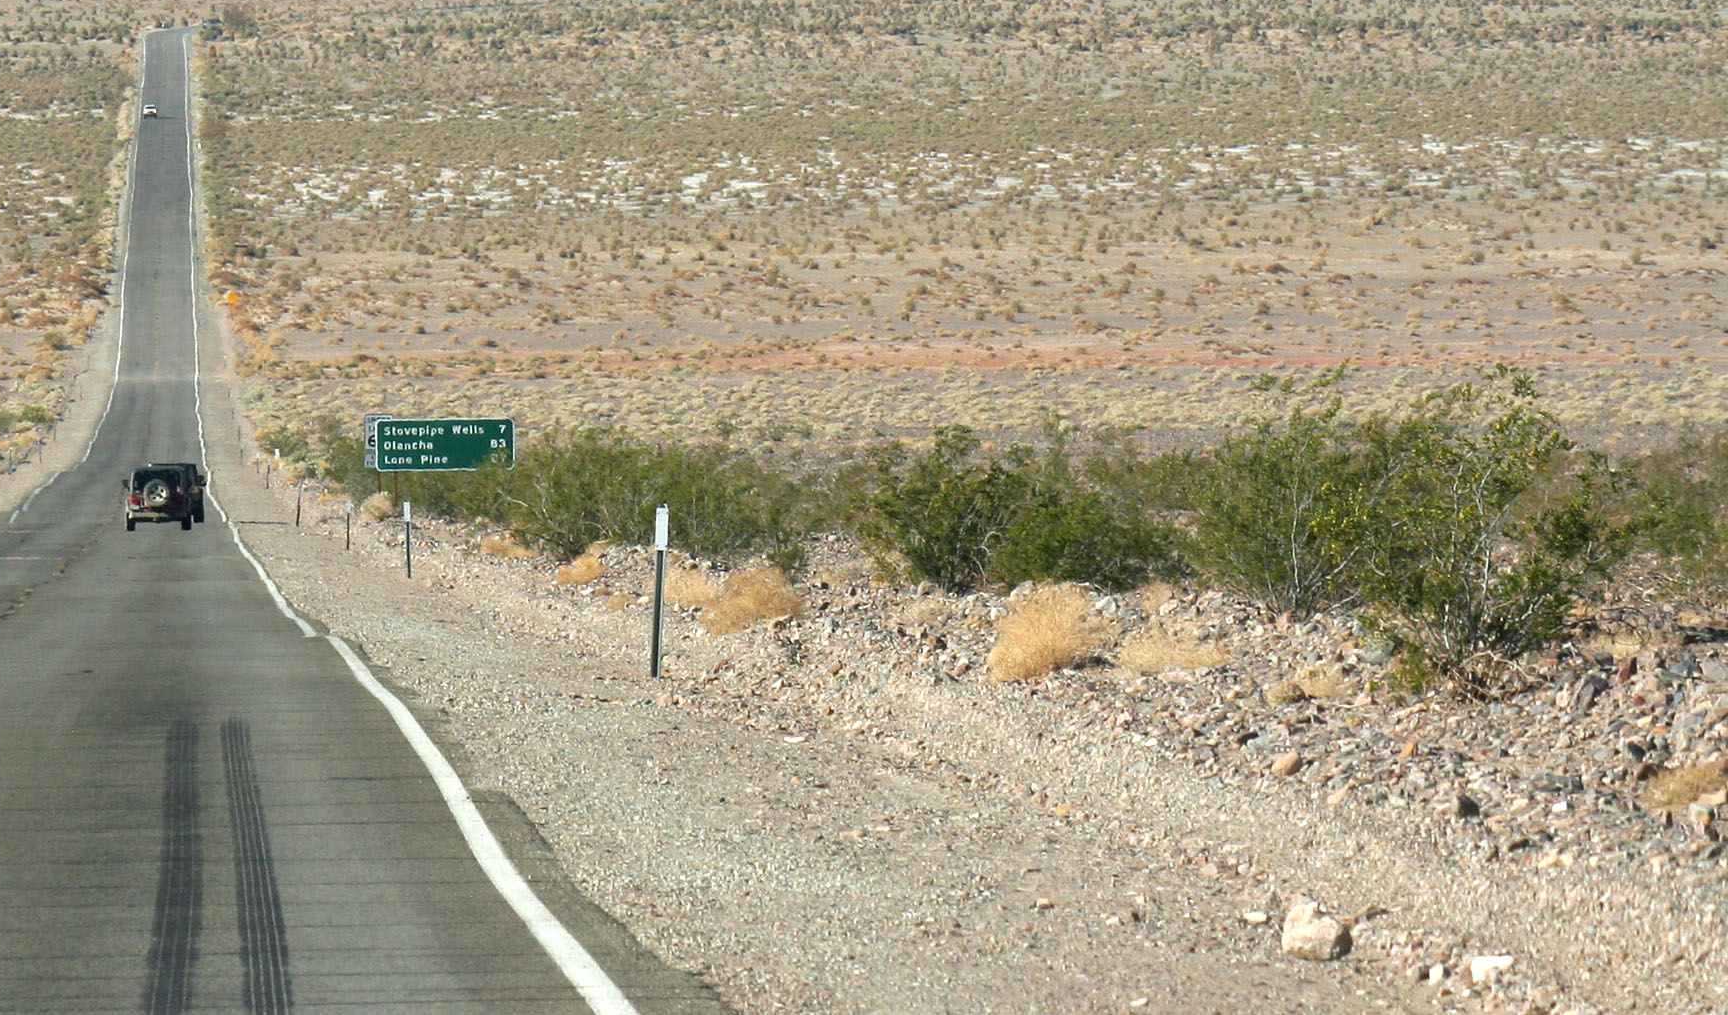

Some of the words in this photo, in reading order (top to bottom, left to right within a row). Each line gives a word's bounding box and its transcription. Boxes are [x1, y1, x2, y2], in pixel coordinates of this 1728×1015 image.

[383, 426, 444, 437] Stovepipe
[452, 425, 485, 435] Wells
[499, 424, 507, 434] 7
[383, 440, 434, 451] Olancha
[384, 455, 413, 465] Lone
[421, 454, 449, 465] Pine
